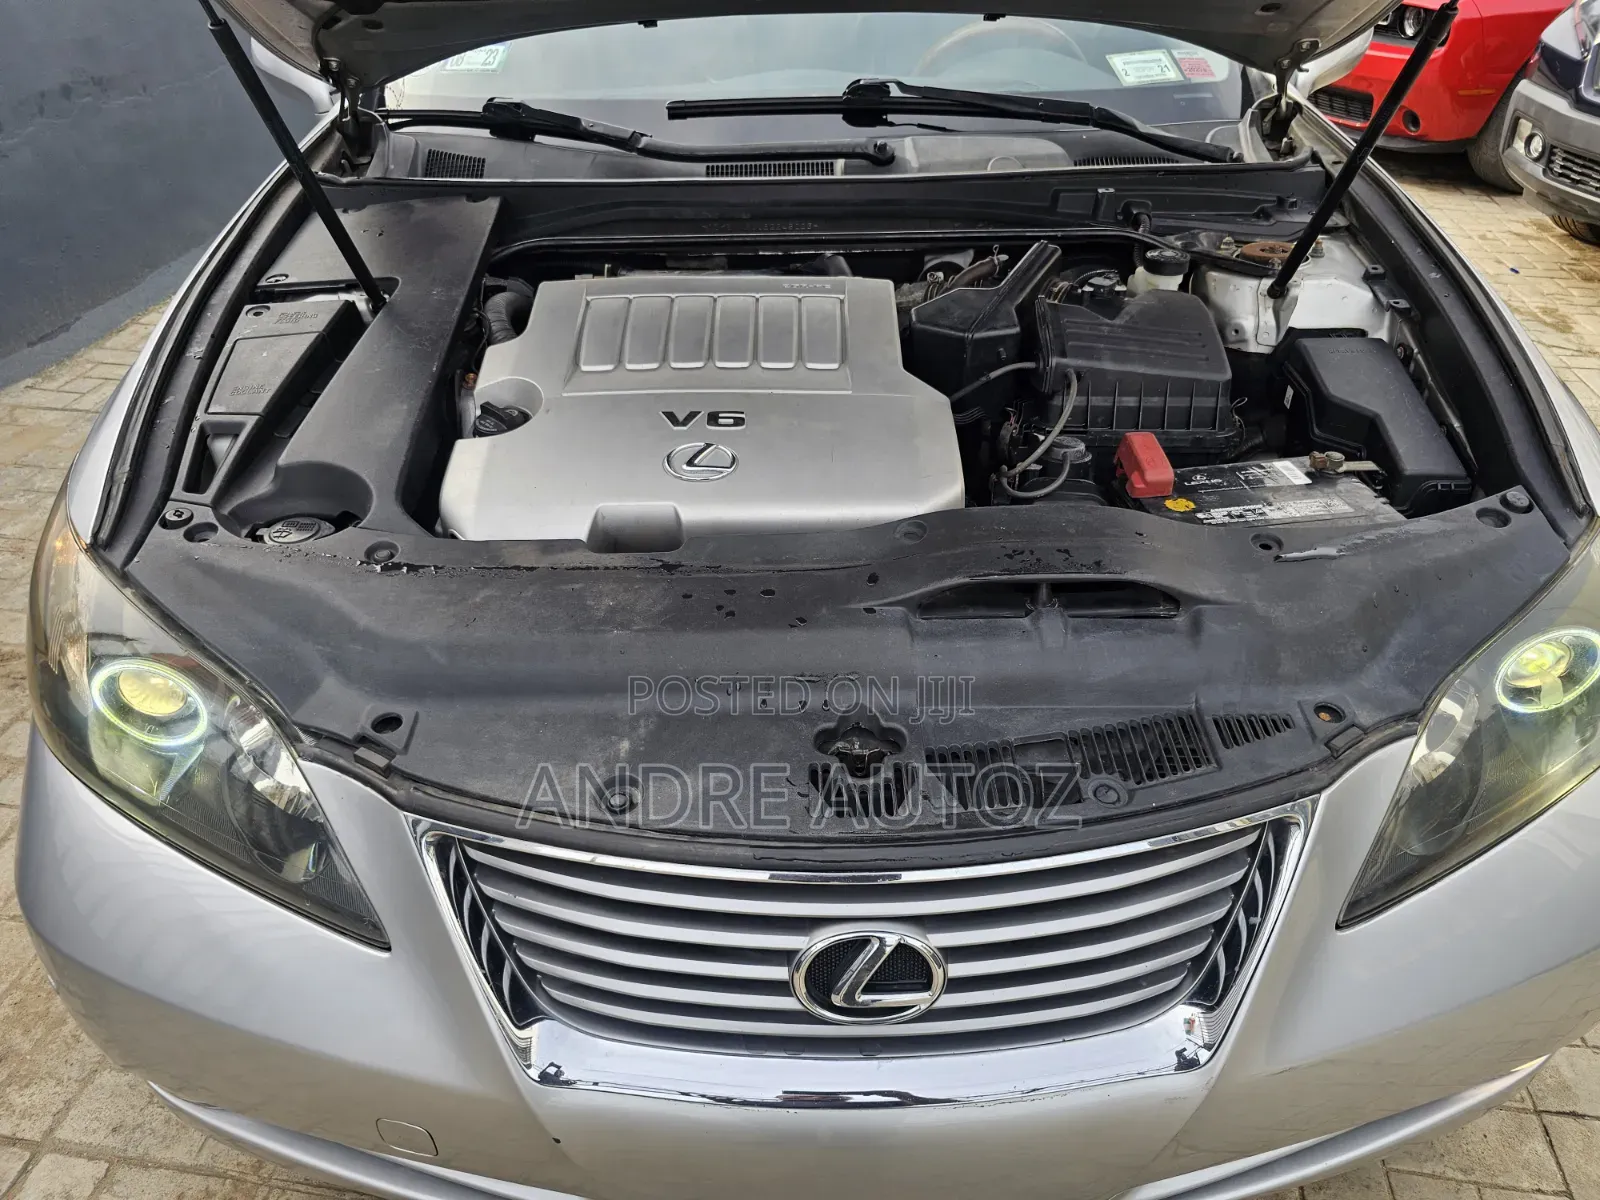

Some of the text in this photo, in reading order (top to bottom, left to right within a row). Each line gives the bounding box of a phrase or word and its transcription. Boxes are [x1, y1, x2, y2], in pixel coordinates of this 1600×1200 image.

[480, 48, 500, 67] 23
[1121, 68, 1130, 77] 2
[659, 410, 747, 430] V6
